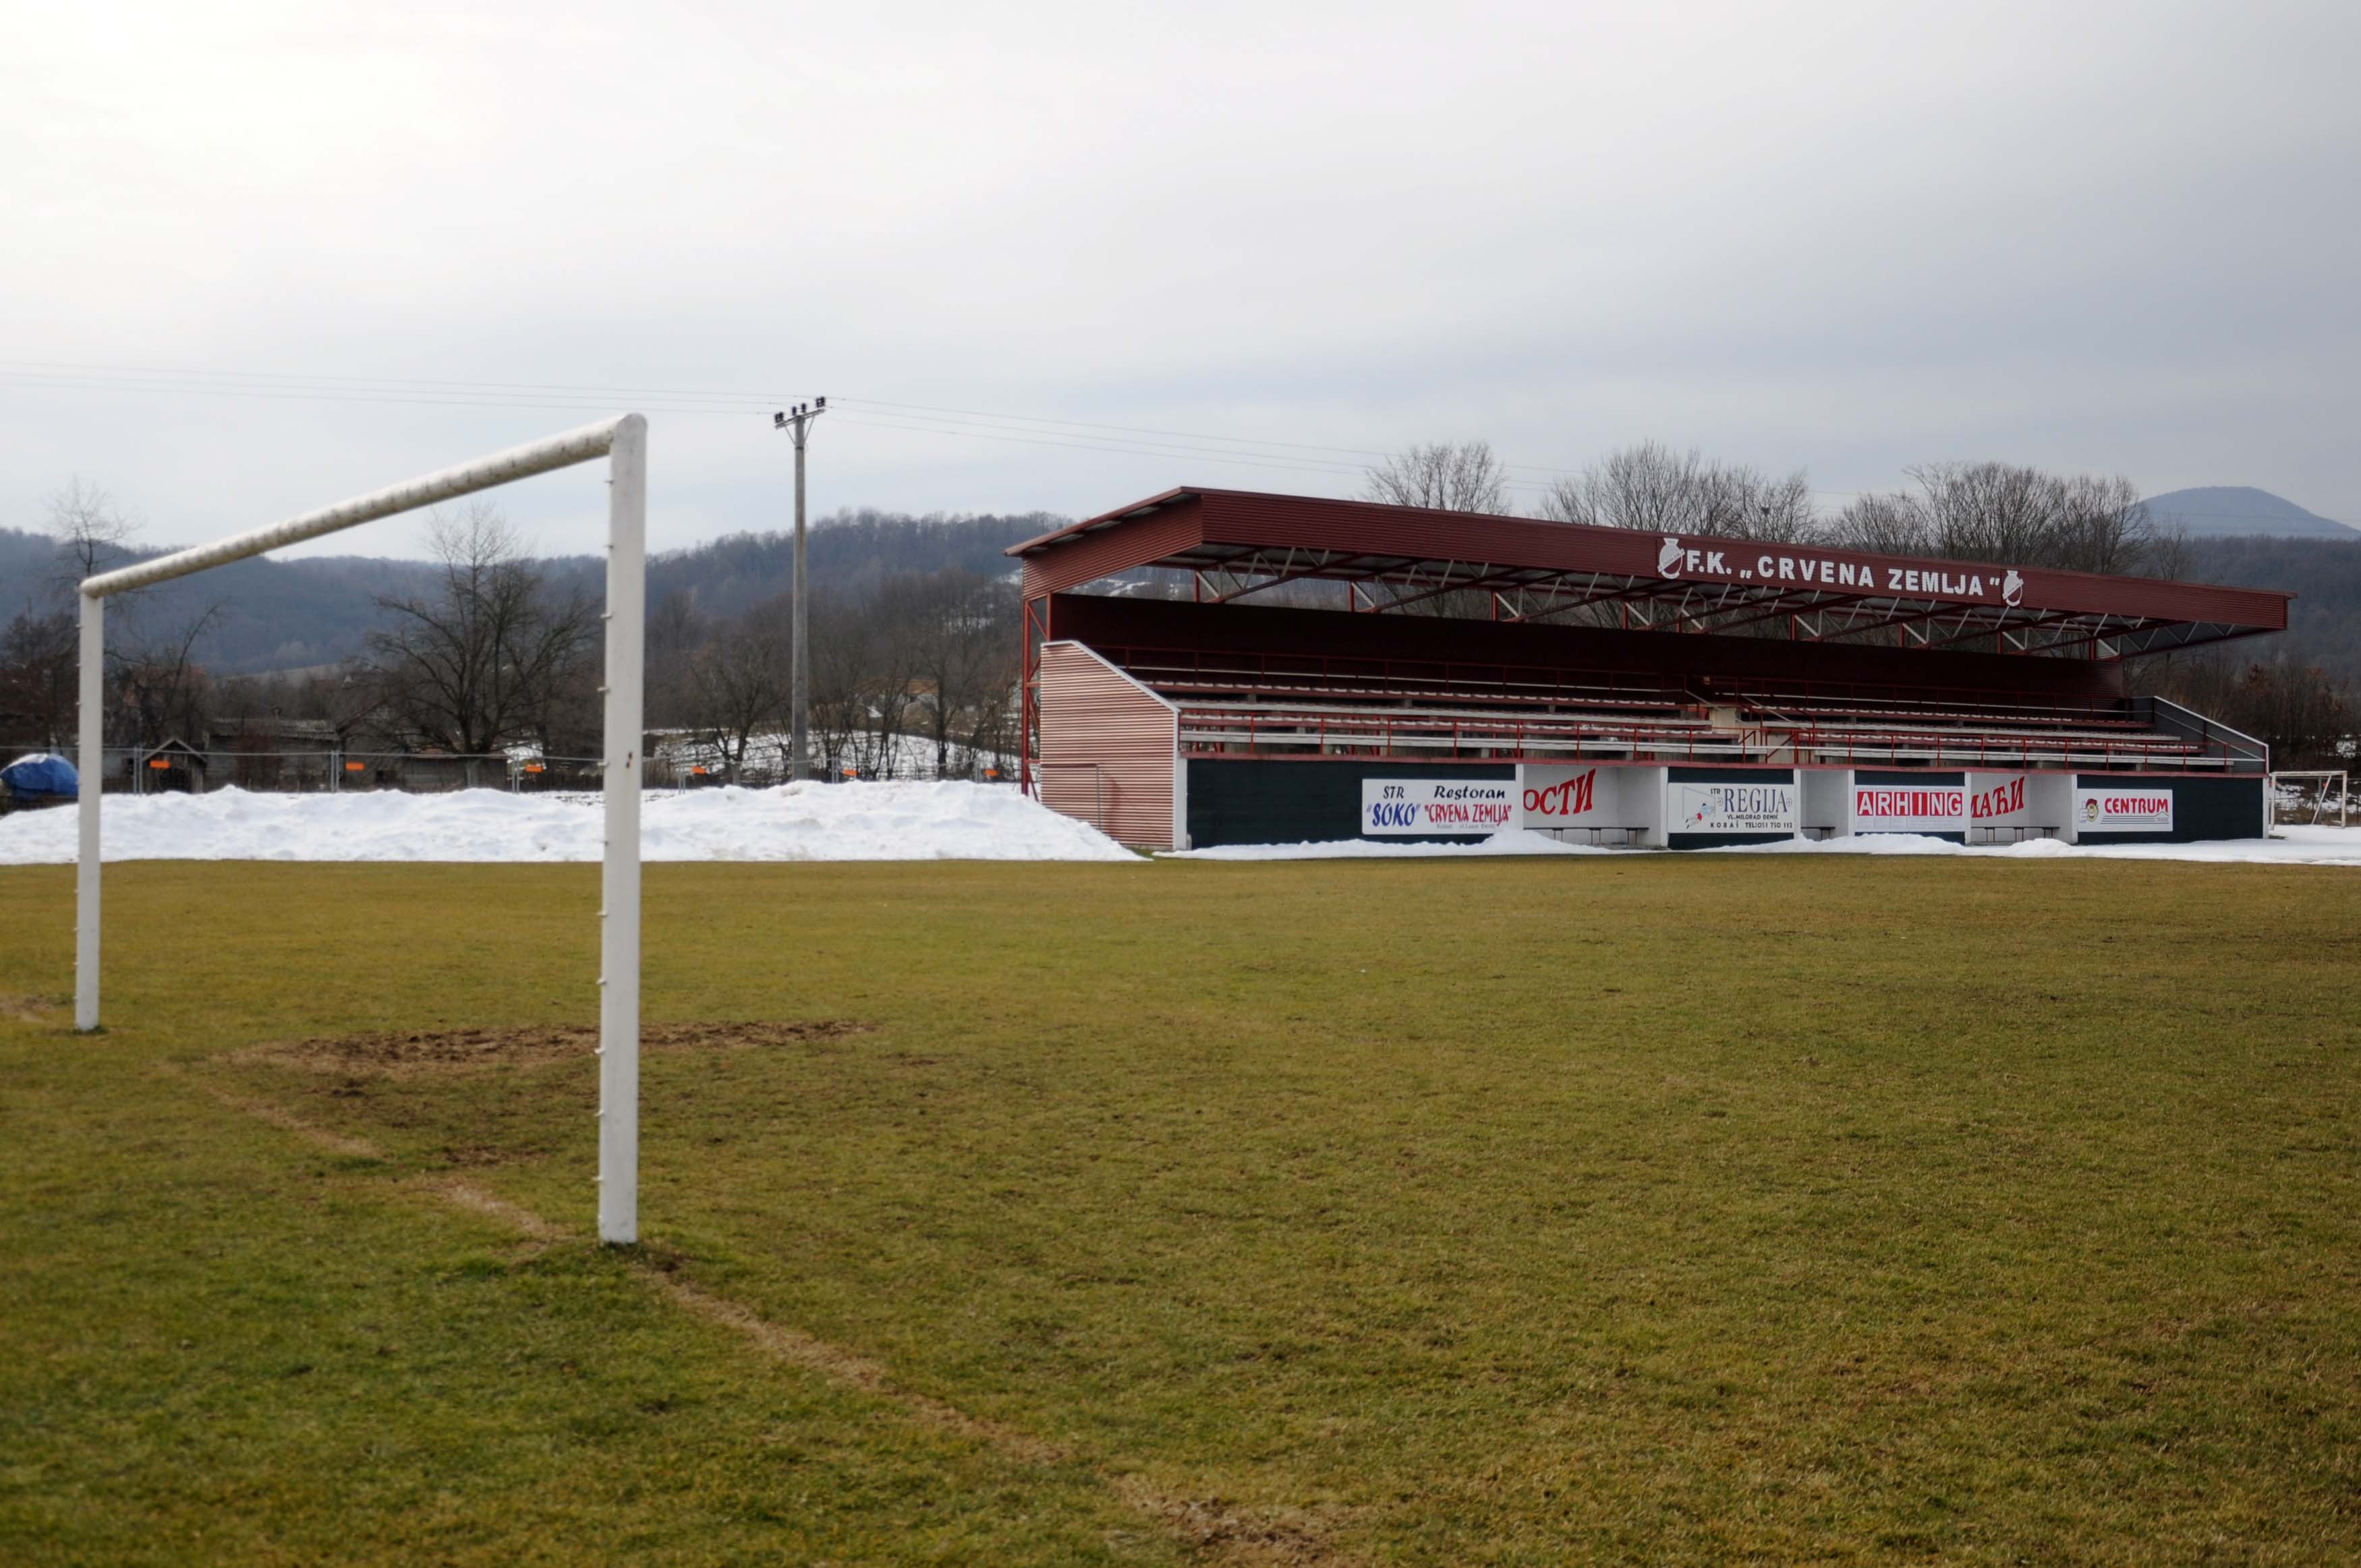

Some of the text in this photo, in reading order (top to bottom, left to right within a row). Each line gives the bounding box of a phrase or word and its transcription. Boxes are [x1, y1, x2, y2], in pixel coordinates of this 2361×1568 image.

[1686, 549, 1732, 575] F.K.
[1383, 786, 1405, 798] STR
[1433, 785, 1505, 800] Restoran
[1723, 788, 1788, 813] REGIJA
[1424, 803, 1512, 826] "CRVENA ZEMLJA"
[1858, 792, 1962, 816] ARHING
[2105, 798, 2169, 813] CENTRUM
